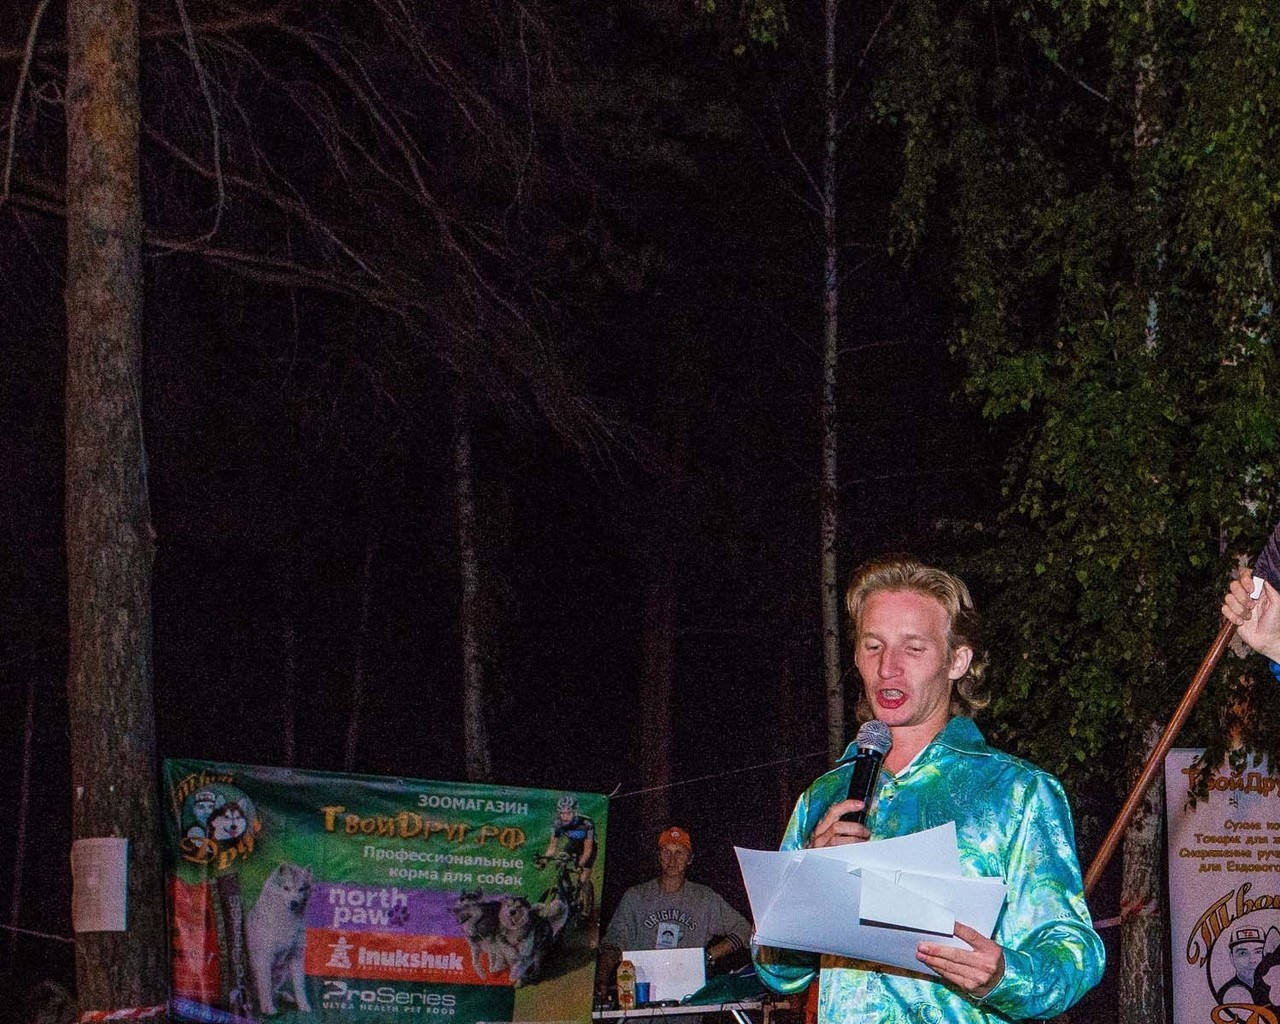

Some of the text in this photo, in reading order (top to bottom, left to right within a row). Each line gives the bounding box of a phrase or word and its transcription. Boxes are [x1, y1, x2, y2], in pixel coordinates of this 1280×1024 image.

[417, 794, 529, 815] ЗООМАГАЗИН
[1194, 833, 1241, 846] Товары
[364, 846, 524, 869] Профессиональные
[389, 867, 523, 886] корма для собак
[329, 888, 408, 908] north
[334, 907, 390, 928] paw
[643, 909, 697, 931] ORIGINALS
[358, 946, 464, 970] Inukshuk
[323, 980, 456, 1007] ProSeries
[360, 1003, 399, 1012] HEALTH
[427, 1007, 455, 1015] FOOD
